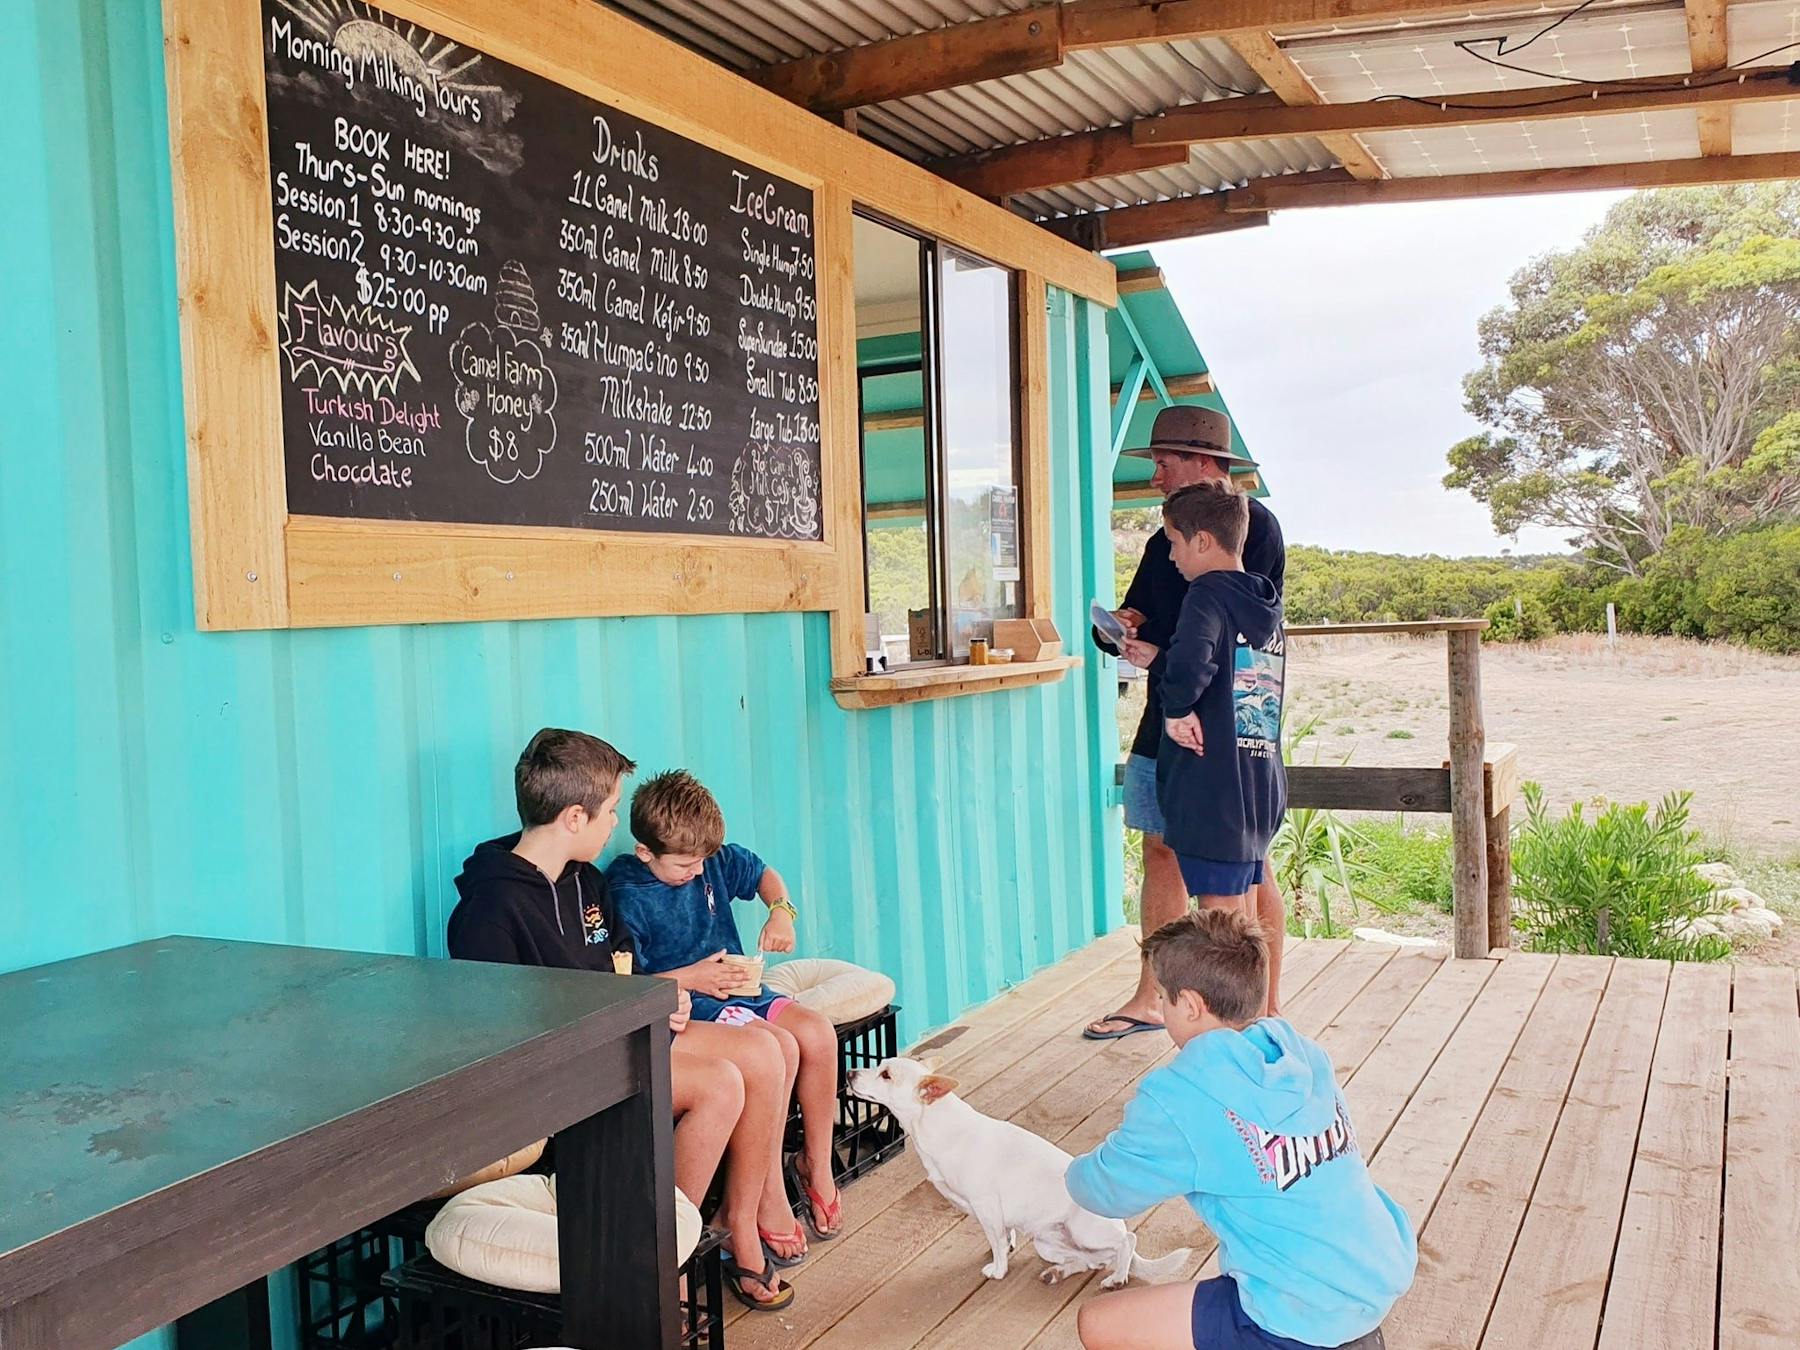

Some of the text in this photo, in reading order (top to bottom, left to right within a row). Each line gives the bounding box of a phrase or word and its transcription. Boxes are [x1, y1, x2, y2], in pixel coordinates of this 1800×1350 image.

[271, 16, 482, 123] Morning Milking Tours
[334, 117, 450, 180] BOOK HERE!
[592, 116, 659, 182] Drinks
[414, 187, 481, 234] mornings
[568, 170, 592, 208] 1L
[595, 174, 634, 223] Camel
[559, 218, 598, 260] 350ml
[602, 225, 641, 274] Camel
[683, 254, 708, 290] 8.50
[741, 227, 770, 274] Single
[772, 243, 795, 283] Hump
[355, 265, 449, 335] $25.00 pp
[557, 268, 710, 342] 350ml Camel Kefir 9.50
[739, 273, 773, 310] Double
[773, 284, 796, 326] Hump
[294, 302, 398, 361] Flavours
[560, 320, 590, 359] 350ml
[461, 344, 543, 390] Camel Farm
[746, 357, 775, 399] Small
[778, 371, 796, 403] Tub
[301, 388, 441, 433] Turkish Delight
[486, 387, 534, 432] Honey
[600, 375, 672, 426] Milkshake
[309, 420, 426, 457] Vanilla Bean
[488, 426, 519, 462] $8
[584, 430, 631, 470] 500ml
[639, 433, 679, 473] Water
[750, 406, 775, 452] Large
[776, 412, 793, 444] Tub
[311, 453, 413, 488] Chocolate
[589, 478, 634, 517] 250ml
[641, 480, 678, 518] Water
